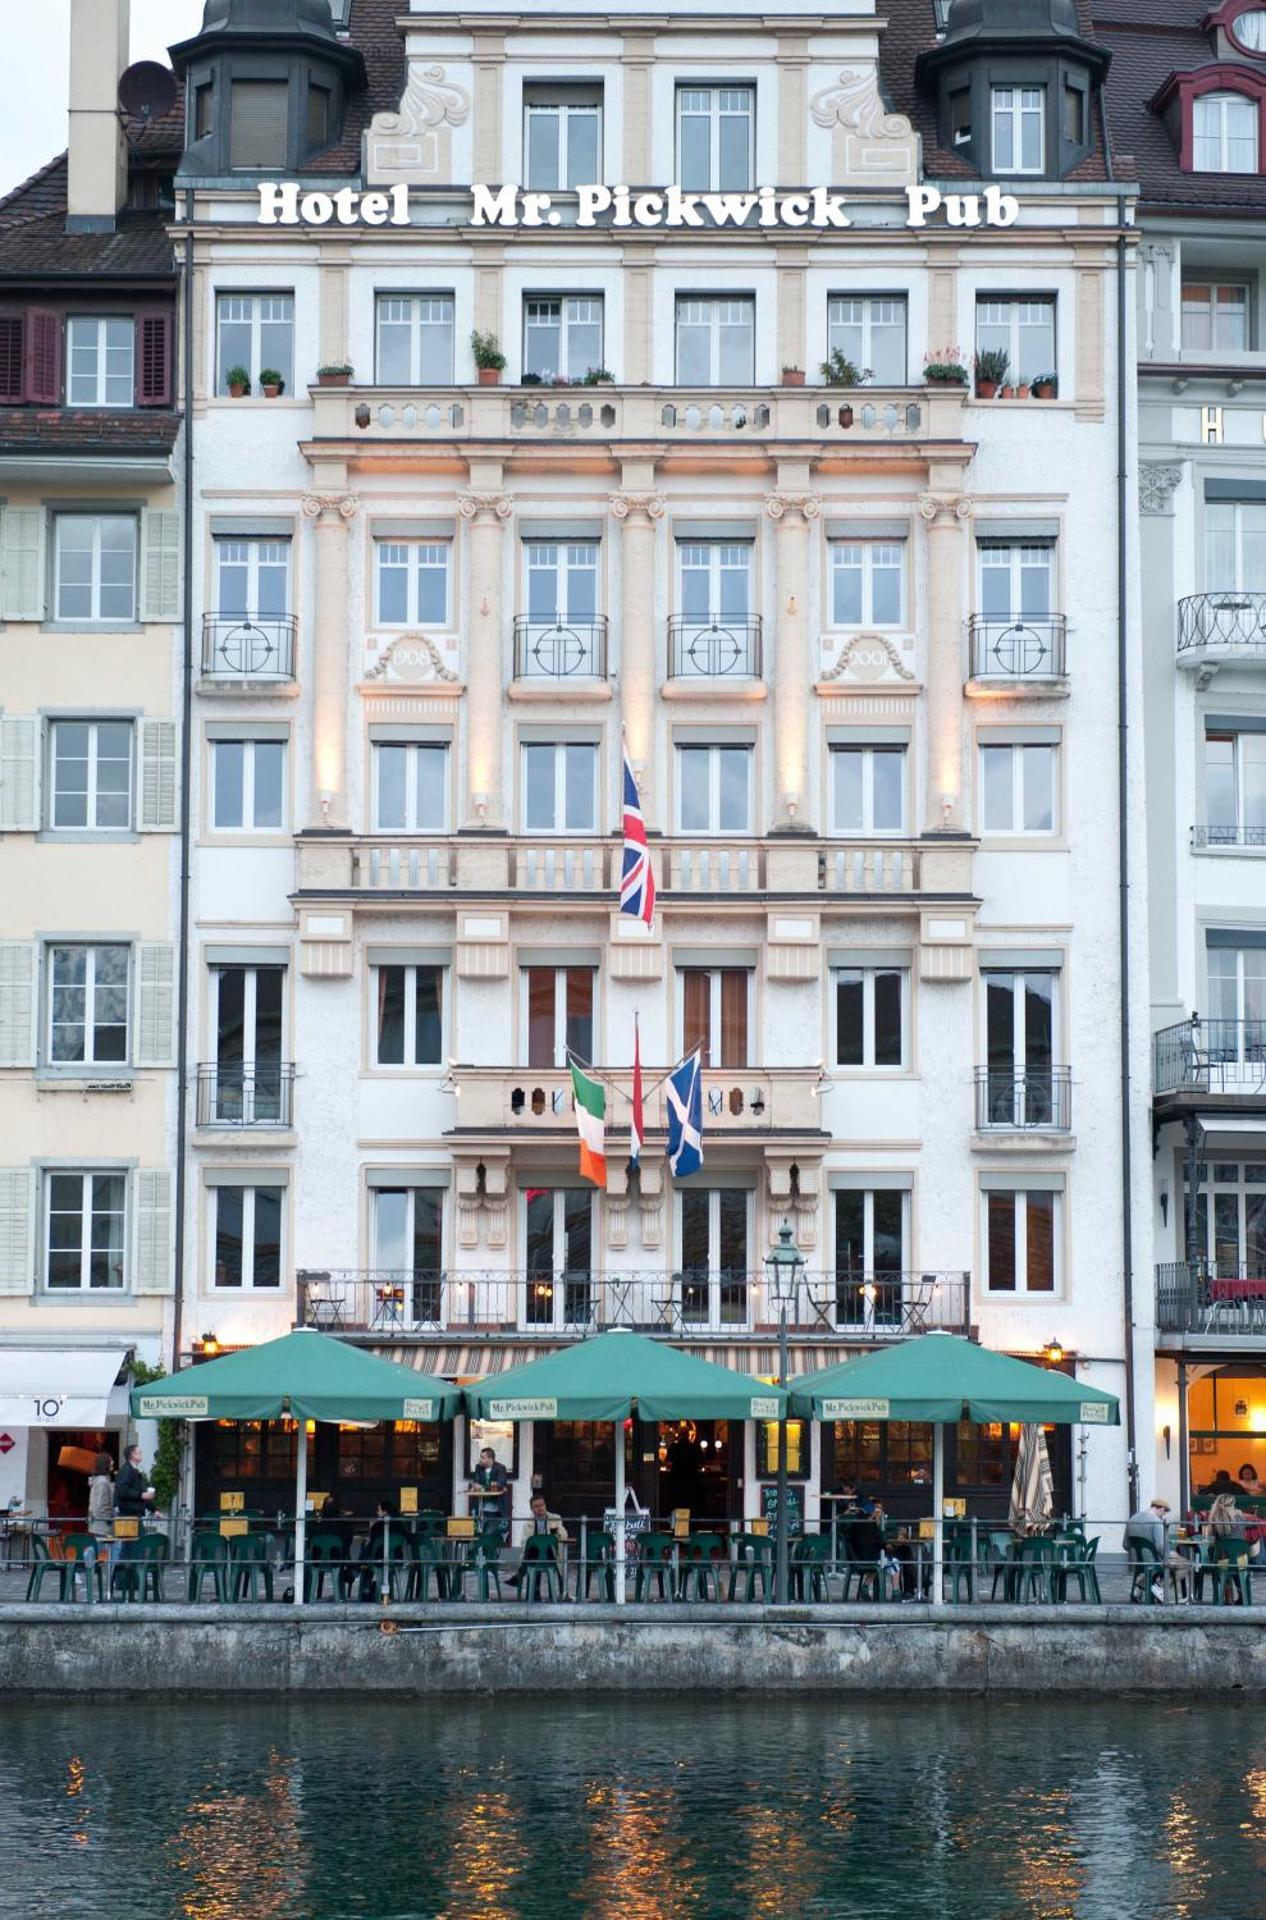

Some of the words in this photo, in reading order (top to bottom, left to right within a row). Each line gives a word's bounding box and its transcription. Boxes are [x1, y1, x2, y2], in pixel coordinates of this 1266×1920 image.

[257, 182, 411, 225] Hotel
[470, 184, 561, 226] Mr.
[575, 184, 852, 227] Pickwick
[905, 184, 1020, 227] Pub
[393, 648, 432, 666] 1908
